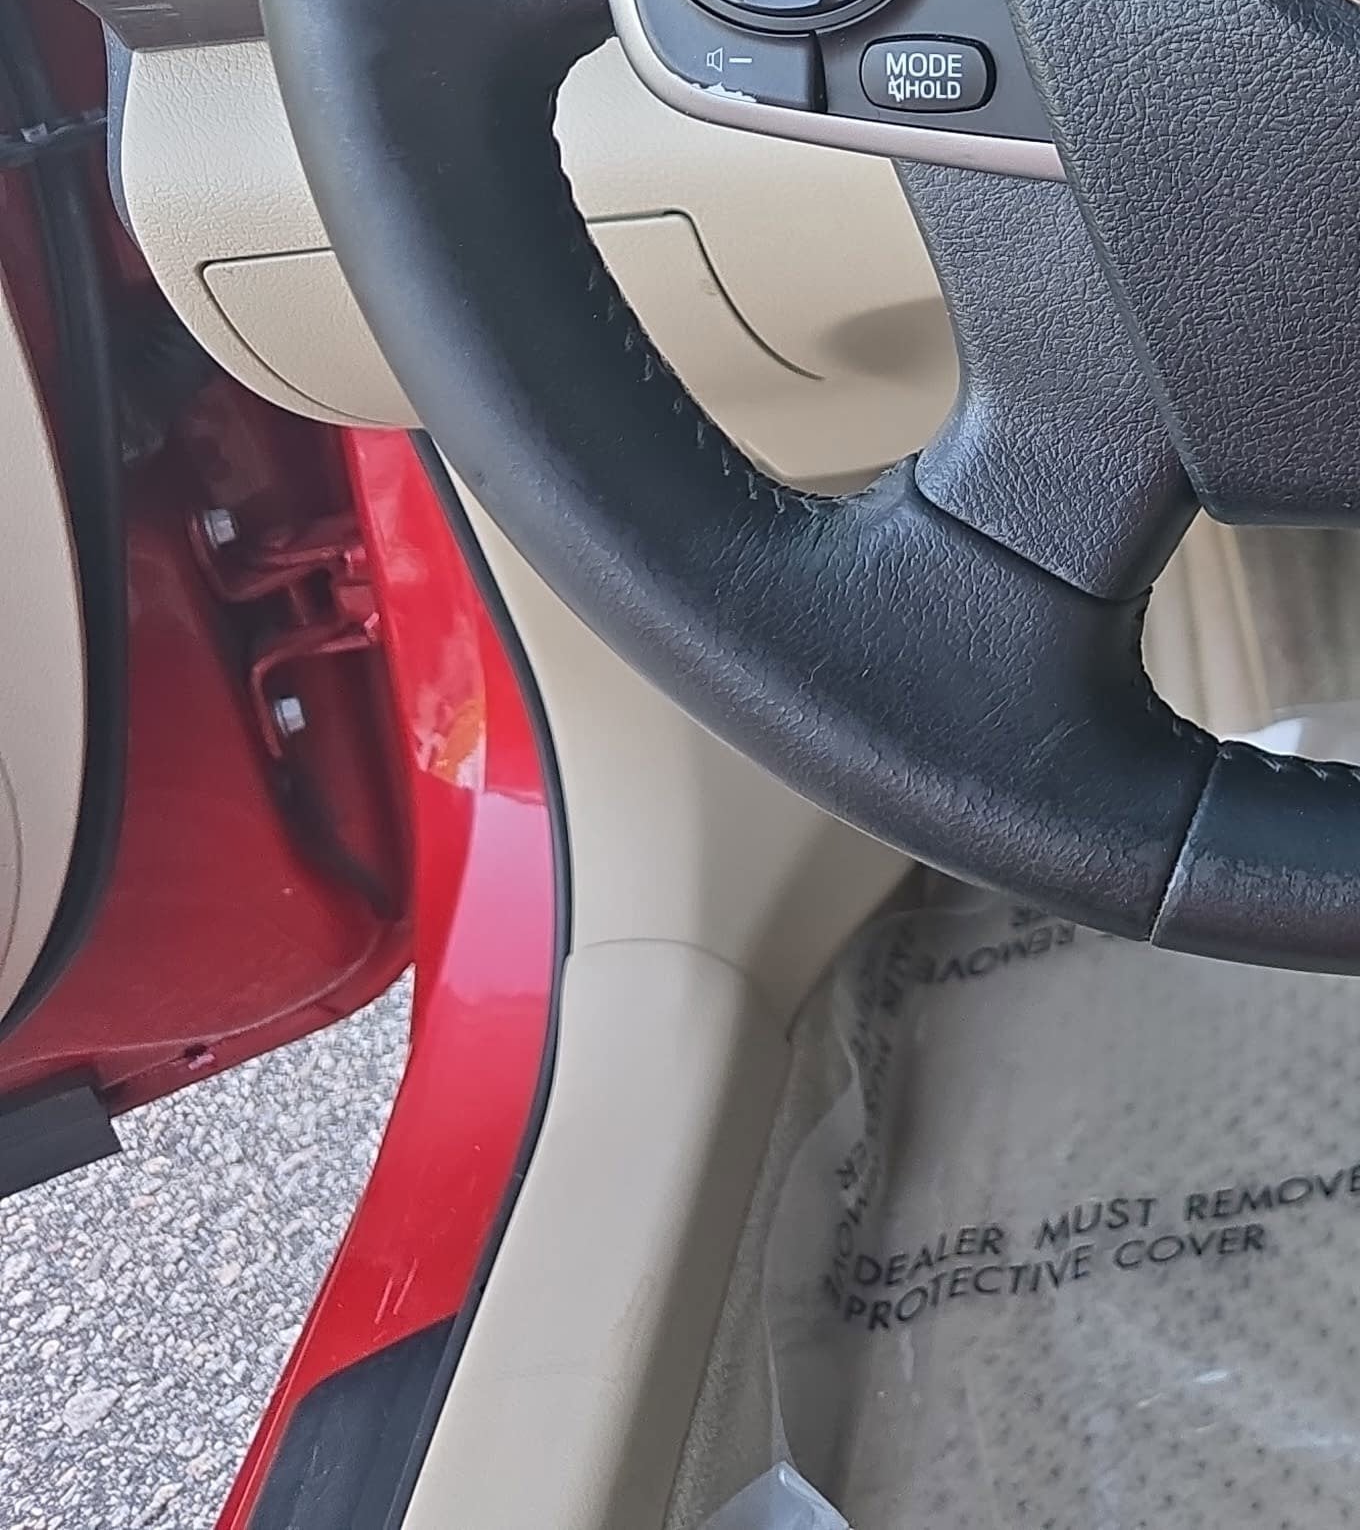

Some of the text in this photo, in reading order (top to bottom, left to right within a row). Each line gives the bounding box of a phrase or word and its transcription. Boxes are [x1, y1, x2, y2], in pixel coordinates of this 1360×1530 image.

[886, 52, 963, 77] MODE
[905, 79, 961, 101] HOLD
[855, 1223, 1006, 1289] DEALER
[1033, 1195, 1157, 1253] MUST
[840, 1223, 1266, 1333] PROTECTIVE COVER
